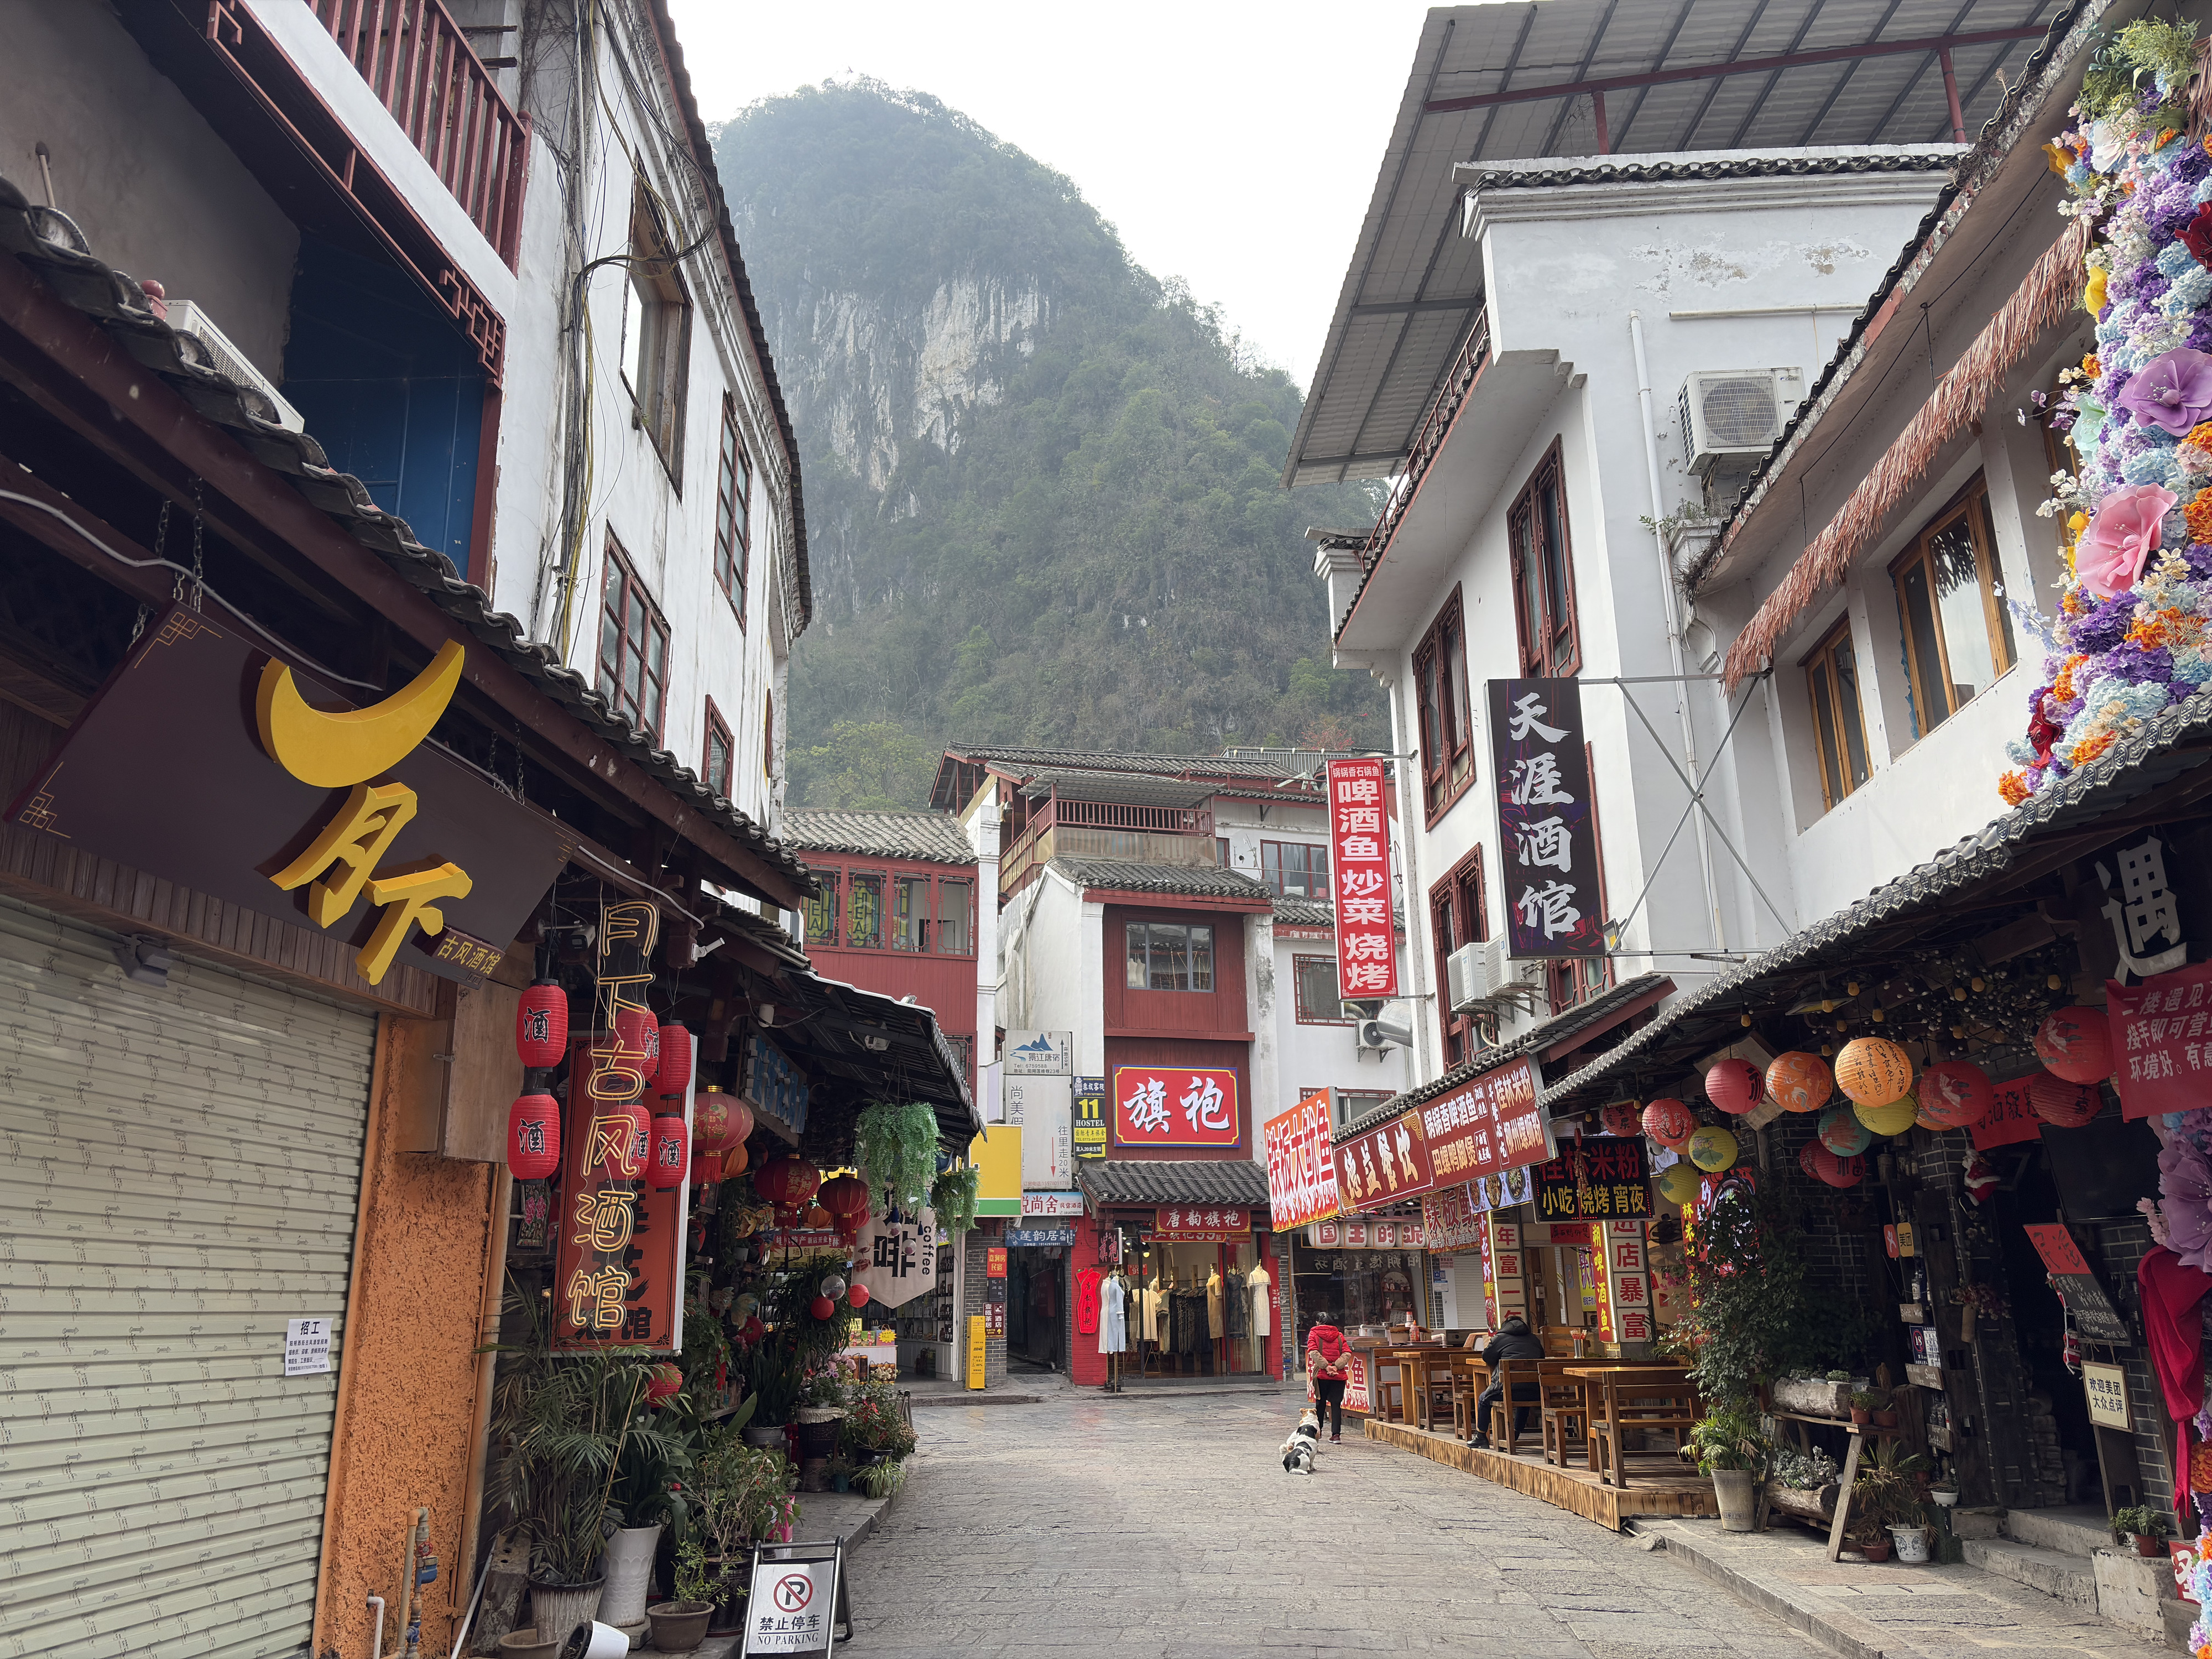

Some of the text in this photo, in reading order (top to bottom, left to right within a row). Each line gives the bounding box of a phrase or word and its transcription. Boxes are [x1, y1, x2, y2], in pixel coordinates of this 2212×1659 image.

[1333, 766, 1380, 778] 锅锅香石锅鱼
[1509, 692, 1580, 941] 天涯酒馆
[269, 781, 472, 985] 月下
[1338, 779, 1390, 990] 啤酒鱼 炒菜 烧烤
[2095, 834, 2187, 987] 遇
[438, 935, 501, 975] 古风酒馆
[2122, 980, 2212, 1016] 二楼遇见
[524, 1006, 551, 1043] 酒
[1029, 1053, 1060, 1061] 景江唐宿
[1123, 1076, 1230, 1134] 旗袍
[1494, 1065, 1533, 1111] 桂林米粉
[568, 901, 659, 1328] 月下古风酒馆
[1079, 1099, 1098, 1118] 11
[1424, 1091, 1479, 1140] 锅锅香啤酒鱼
[1488, 1083, 1507, 1158] 早餐必吃
[518, 1118, 545, 1155] 酒
[1266, 1099, 1335, 1200] 铁板大鱿鱼
[1503, 1110, 1543, 1155] 柳州螺蛳粉
[659, 1136, 681, 1168] 酒
[1058, 1125, 1069, 1178] 往里走20米
[1432, 1135, 1478, 1177] 田螺鸭脚煲
[1543, 1185, 1575, 1215] 小吃
[1580, 1184, 1609, 1214] 烧烤
[1613, 1183, 1646, 1214] 宵夜
[1020, 1230, 1059, 1241] 莲韵居
[1060, 1230, 1066, 1241] 民宿
[1166, 1208, 1241, 1228] 唐韵旗袍
[1319, 1223, 1423, 1244] 国王的泥
[922, 1225, 935, 1275] coffee
[1899, 1232, 1912, 1248] 美团
[1592, 1224, 1610, 1333] 朔啤酒鱼
[300, 1321, 320, 1335] 招工
[995, 1316, 1003, 1328] 酒店
[1914, 1335, 1923, 1346] 18
[2089, 1377, 2121, 1396] 欢迎美团
[2093, 1394, 2124, 1413] 大众点评
[757, 1632, 819, 1645] NO PARKING
[759, 1614, 821, 1631] 禁止停车
